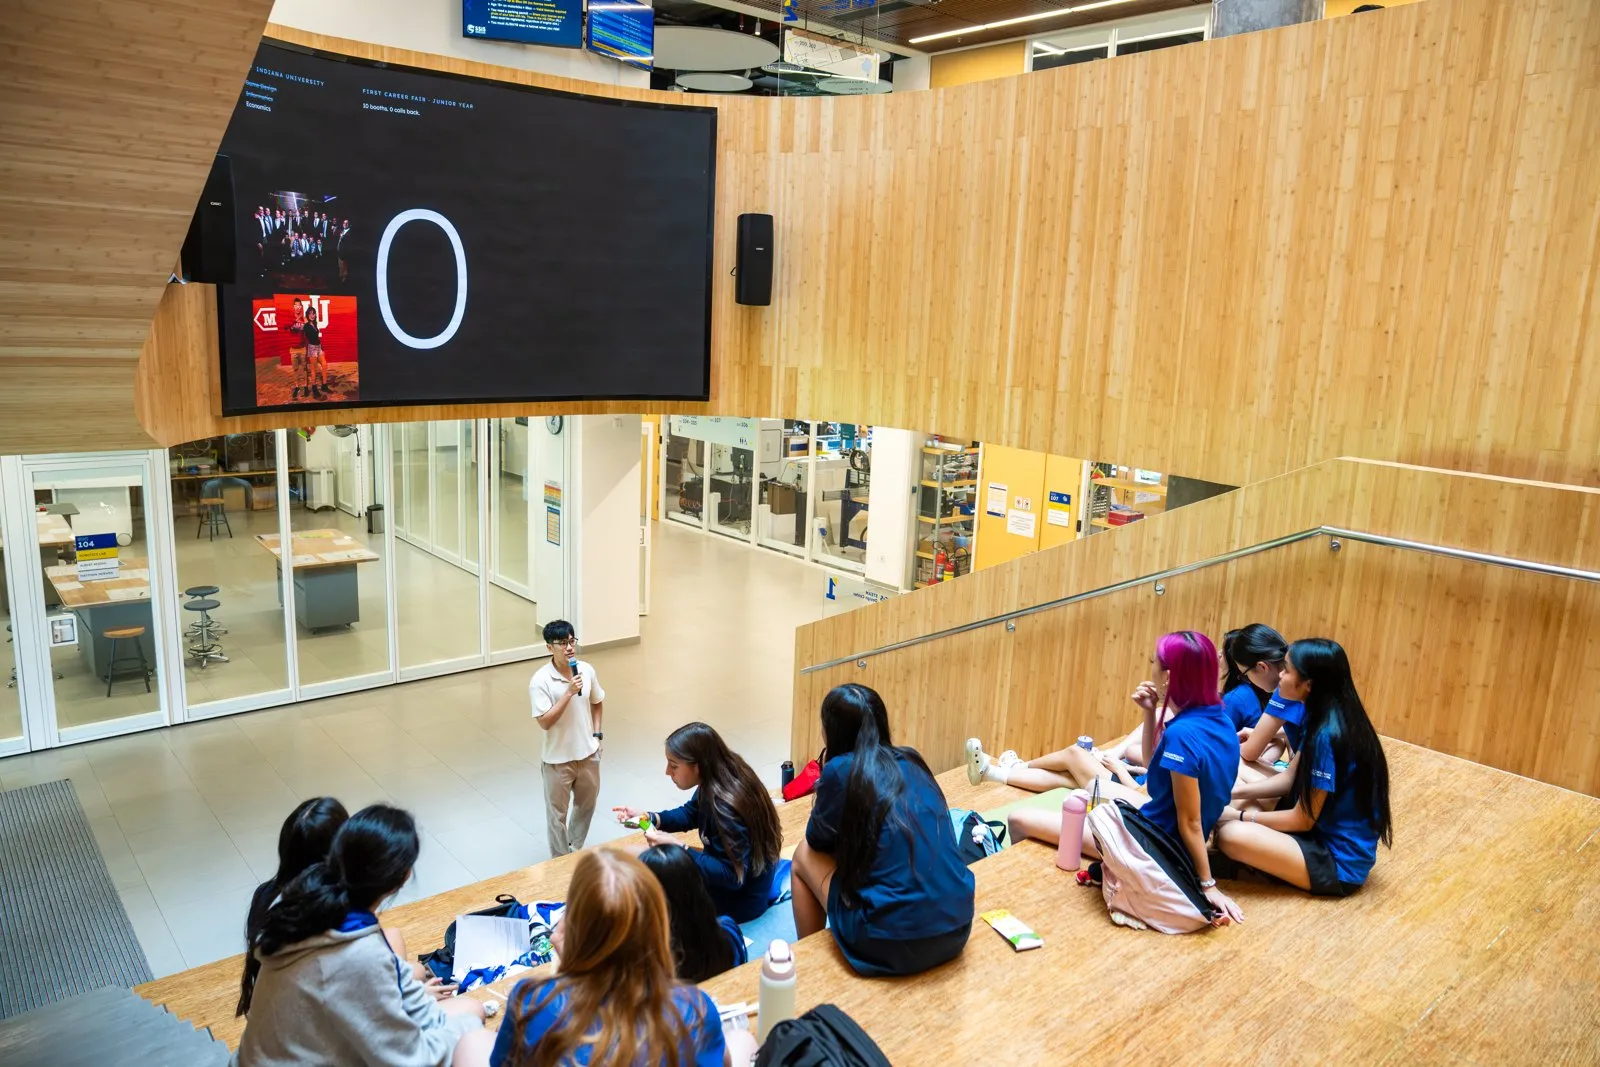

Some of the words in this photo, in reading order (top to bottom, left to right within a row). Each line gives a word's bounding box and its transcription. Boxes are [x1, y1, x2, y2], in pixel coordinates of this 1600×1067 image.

[256, 66, 283, 78] INDIANA
[285, 74, 324, 86] UNIVERSITY
[384, 91, 409, 100] CAREER
[432, 98, 456, 106] JUNIOR
[245, 101, 271, 112] Economics
[262, 313, 277, 326] M
